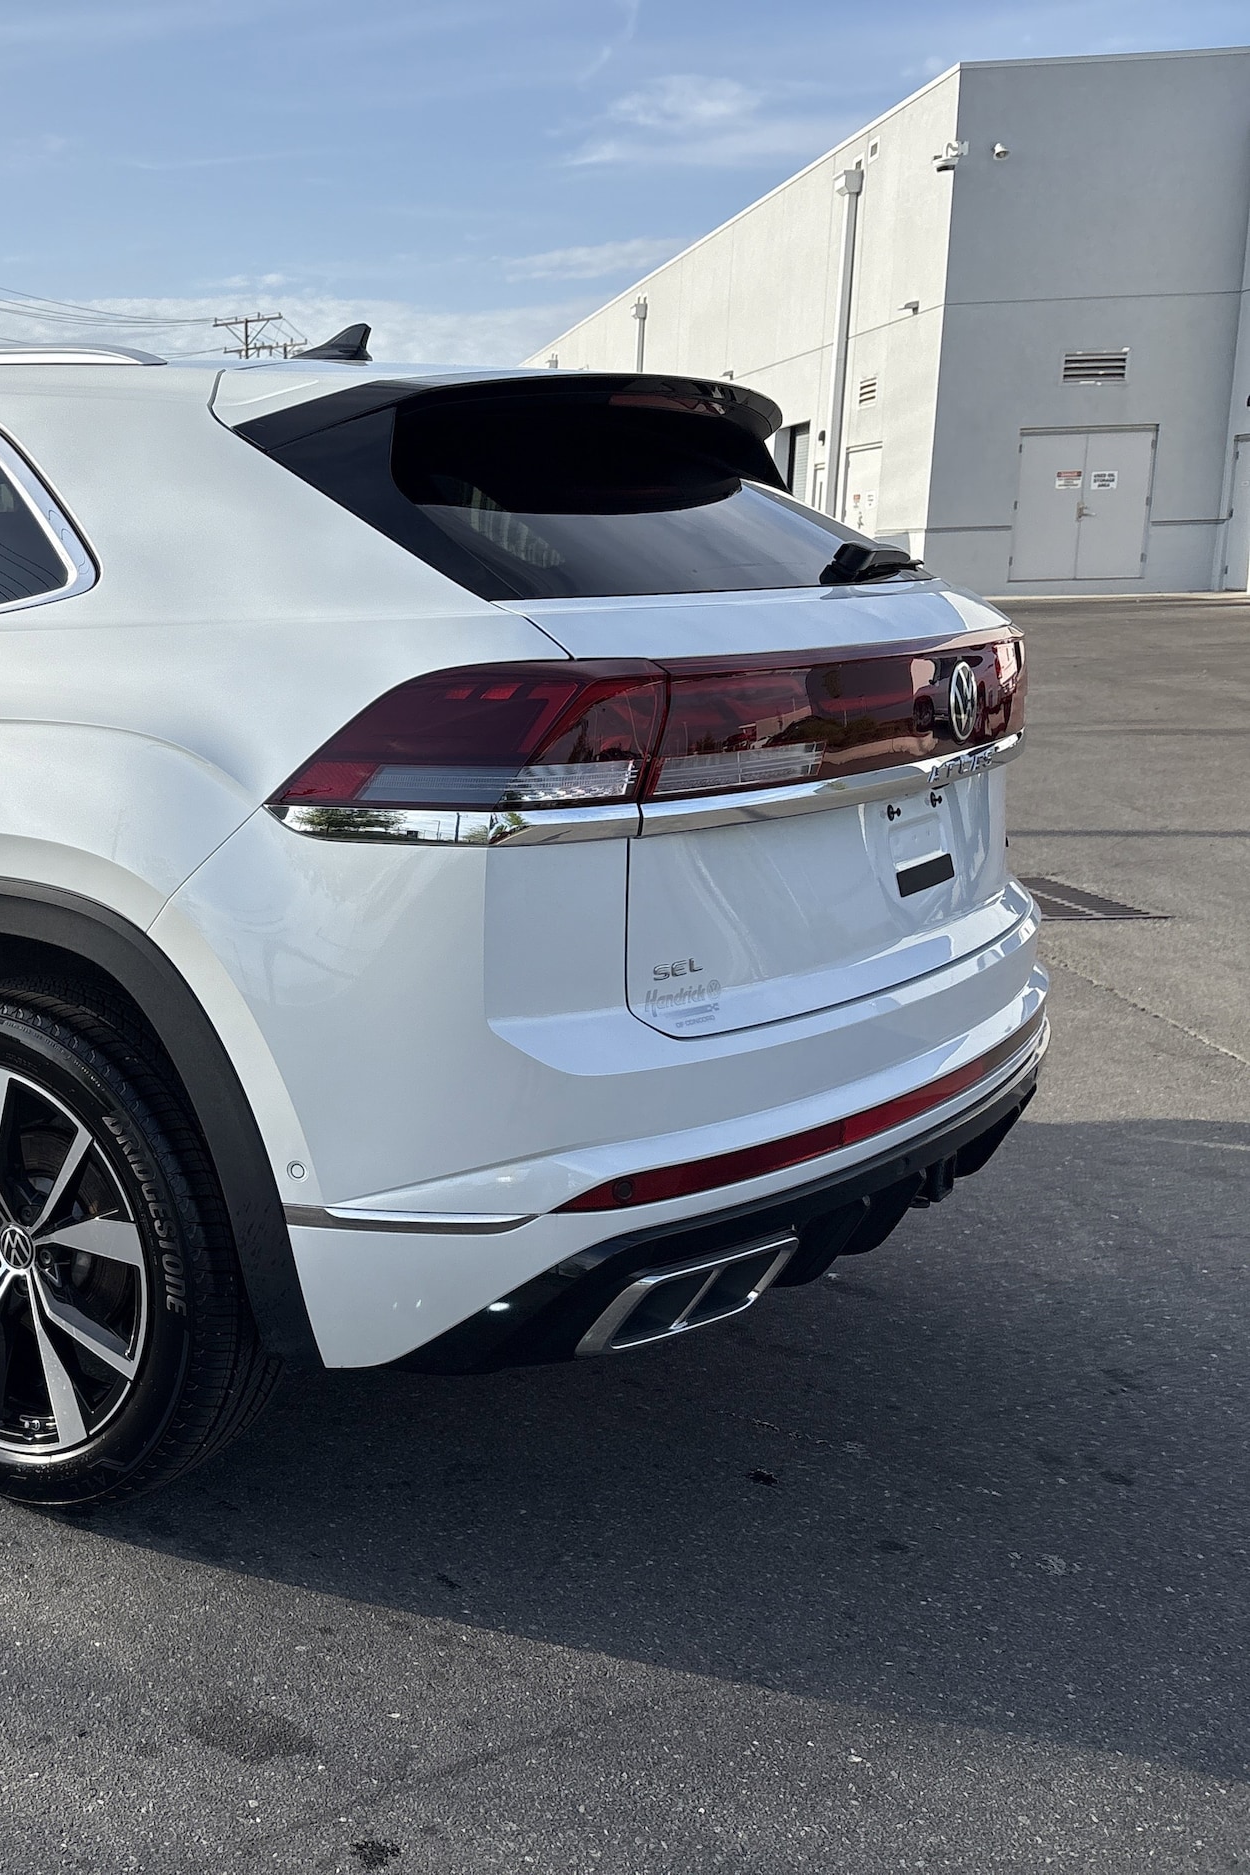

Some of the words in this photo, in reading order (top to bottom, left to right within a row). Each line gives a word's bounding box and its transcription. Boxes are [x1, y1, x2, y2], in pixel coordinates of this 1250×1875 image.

[927, 750, 992, 783] ATLAS
[653, 957, 704, 981] SEL
[645, 984, 706, 1018] Hendrick
[102, 1115, 188, 1317] BRIDGESTONE
